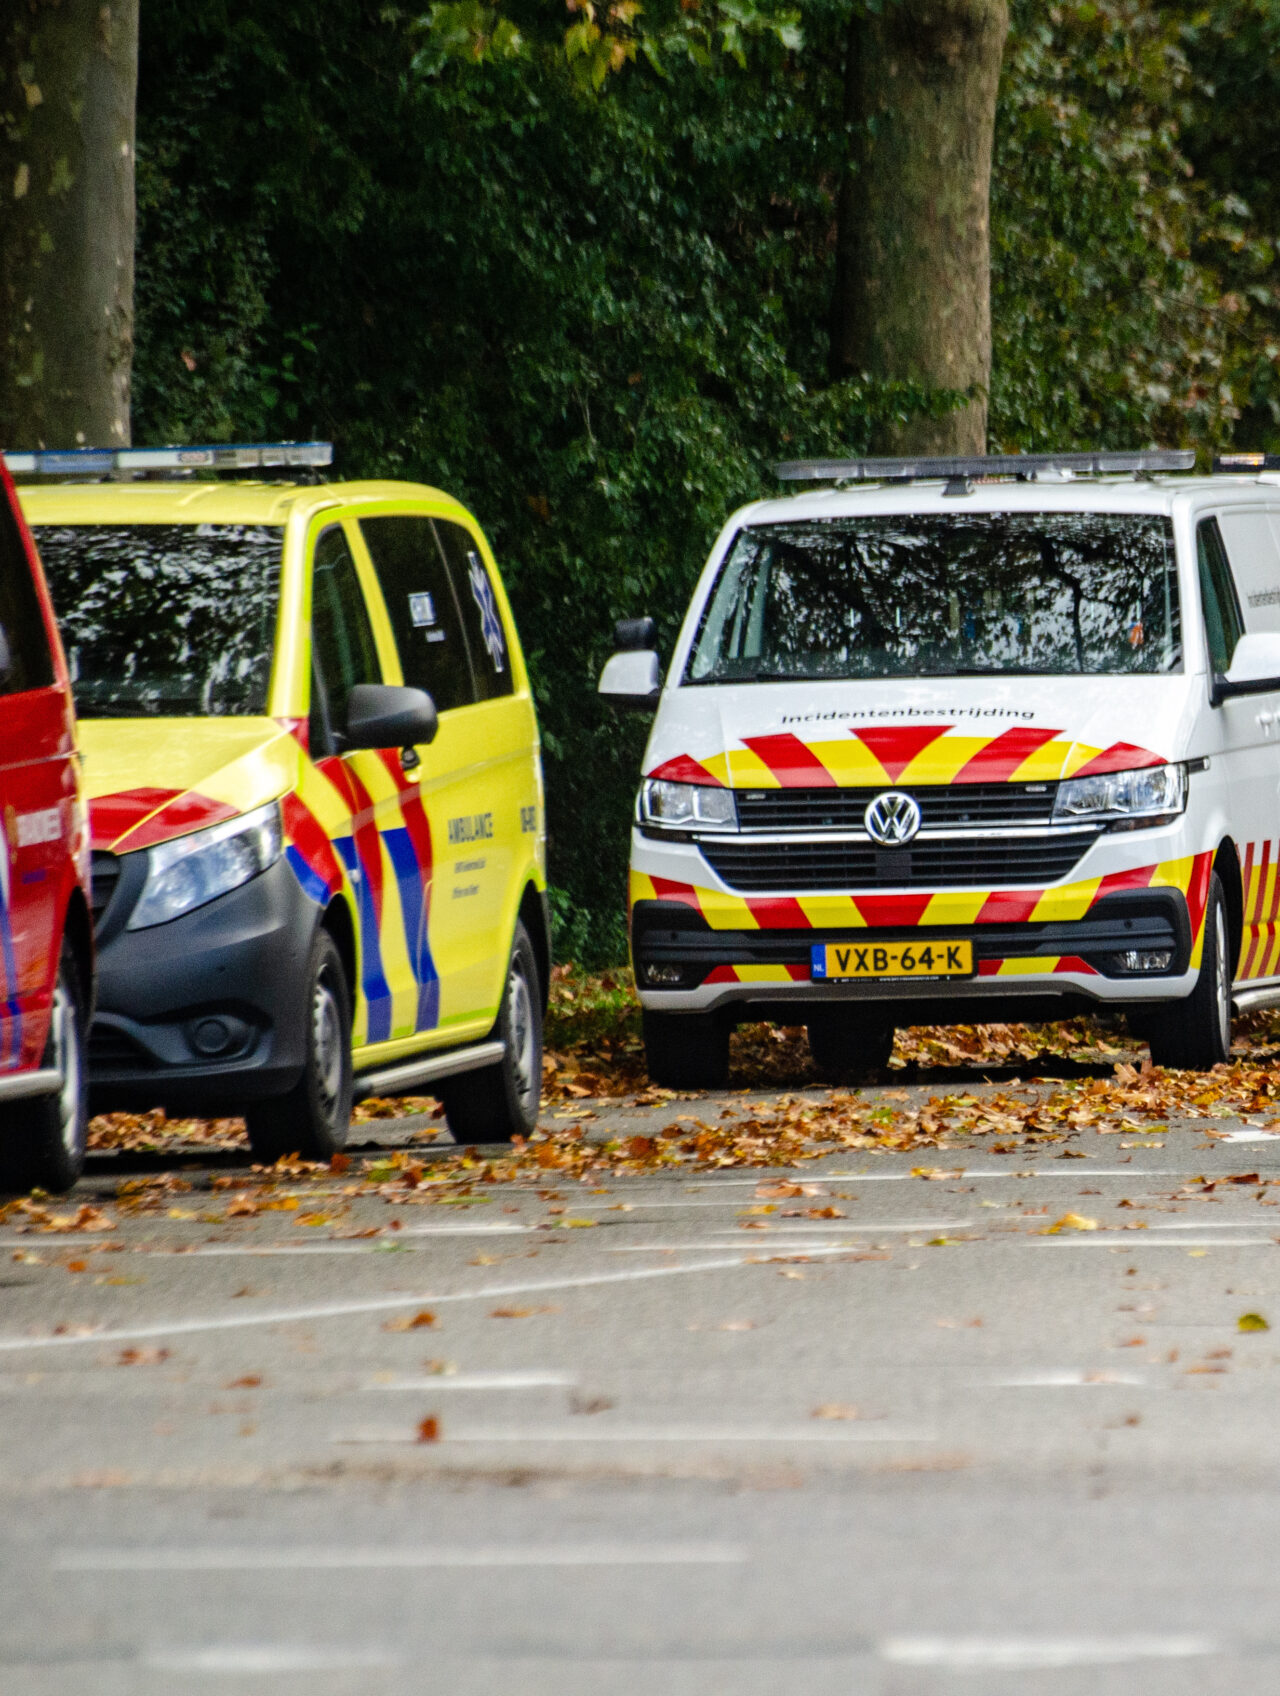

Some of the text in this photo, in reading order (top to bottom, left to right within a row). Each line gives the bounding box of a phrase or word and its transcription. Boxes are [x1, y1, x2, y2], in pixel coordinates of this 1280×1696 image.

[782, 706, 1035, 724] Incidentenbestrijding
[813, 946, 963, 972] NL VXB-64-K
